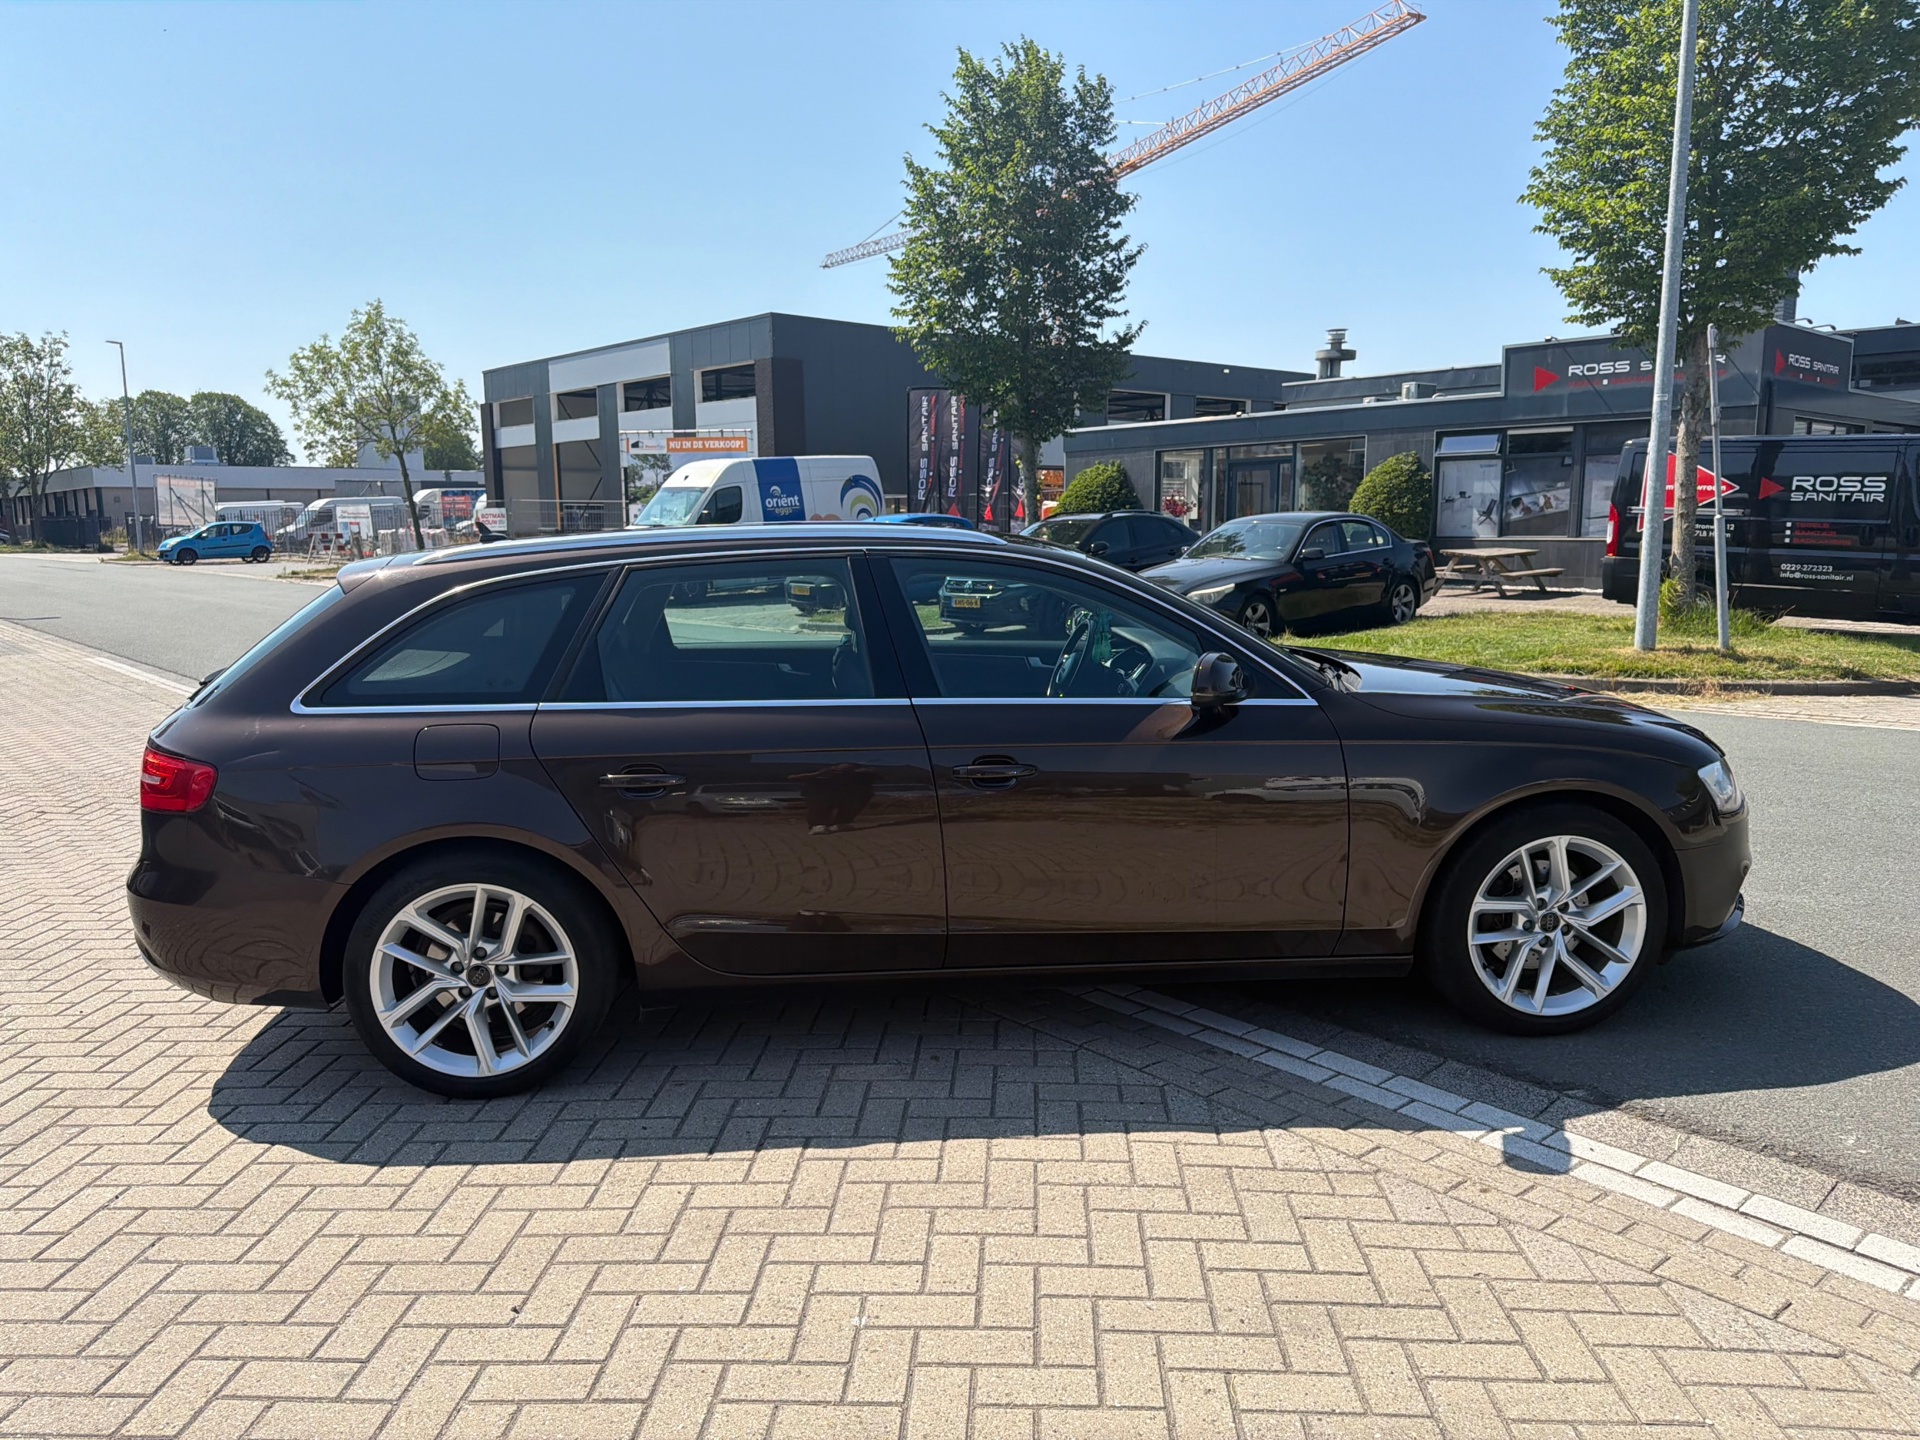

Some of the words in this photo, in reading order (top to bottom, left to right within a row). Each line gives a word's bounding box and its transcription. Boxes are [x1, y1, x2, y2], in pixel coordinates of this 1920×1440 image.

[1568, 360, 1630, 377] ROSS
[1788, 353, 1811, 369] ROSS
[1812, 361, 1840, 375] SANITAIR
[921, 396, 929, 452] SANITAIR
[950, 396, 959, 450] SANITAIR
[669, 441, 681, 449] NU
[682, 441, 692, 449] IN
[693, 440, 704, 449] DE
[704, 440, 744, 449] VERKOOP!
[917, 458, 928, 500] ROSS
[947, 456, 958, 498] ROSS
[1791, 476, 1887, 491] ROSS
[765, 494, 800, 508] oriënt
[1790, 492, 1885, 503] SANITAIR
[775, 507, 793, 516] eggs
[1726, 523, 1736, 531] 12
